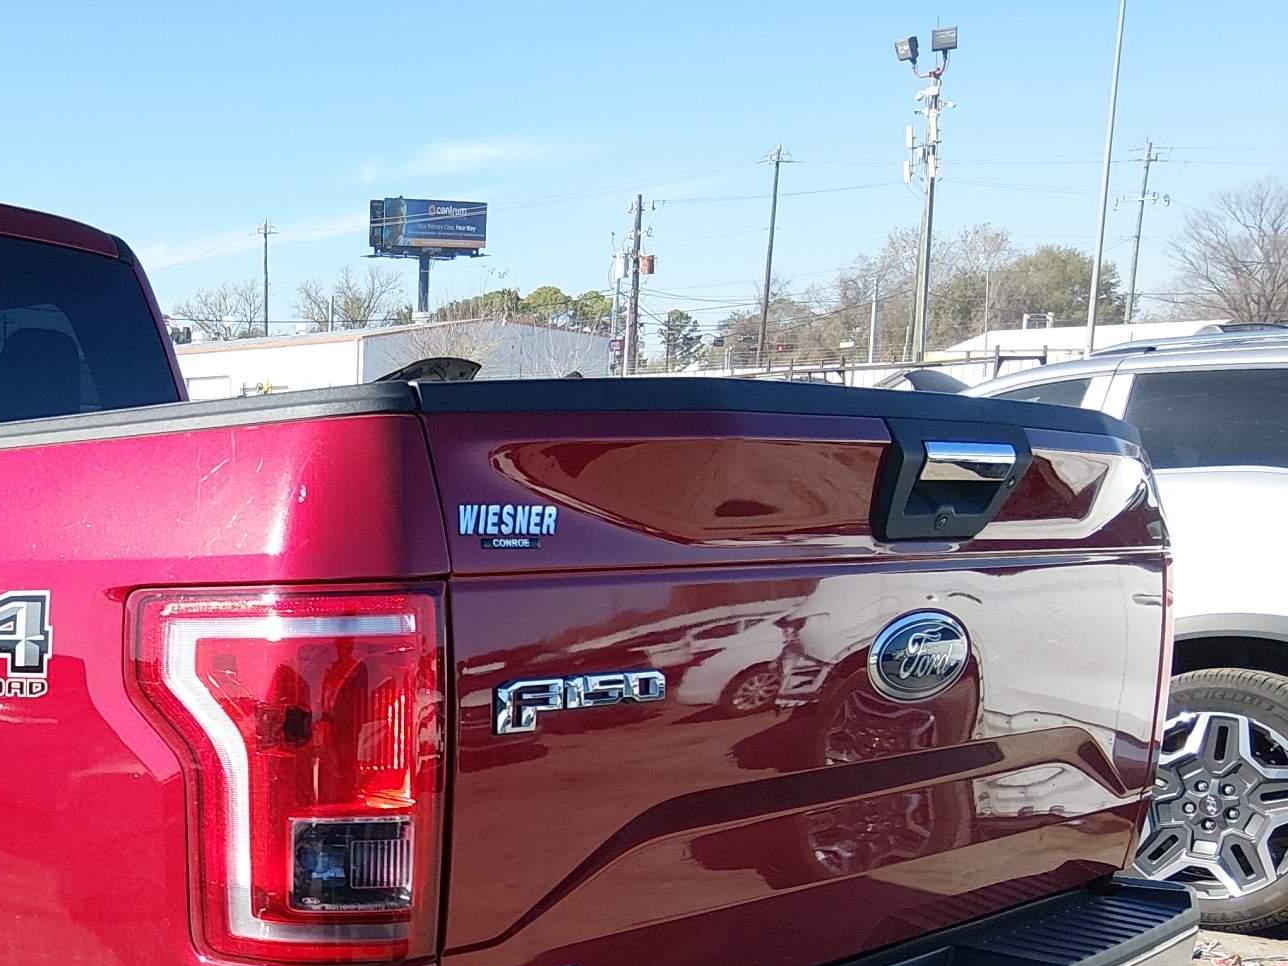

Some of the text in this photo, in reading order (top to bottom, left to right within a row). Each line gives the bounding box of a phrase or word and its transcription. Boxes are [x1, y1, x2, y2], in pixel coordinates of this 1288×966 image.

[459, 504, 557, 535] WIESNER
[492, 538, 530, 548] CONROE
[899, 625, 954, 680] Ford
